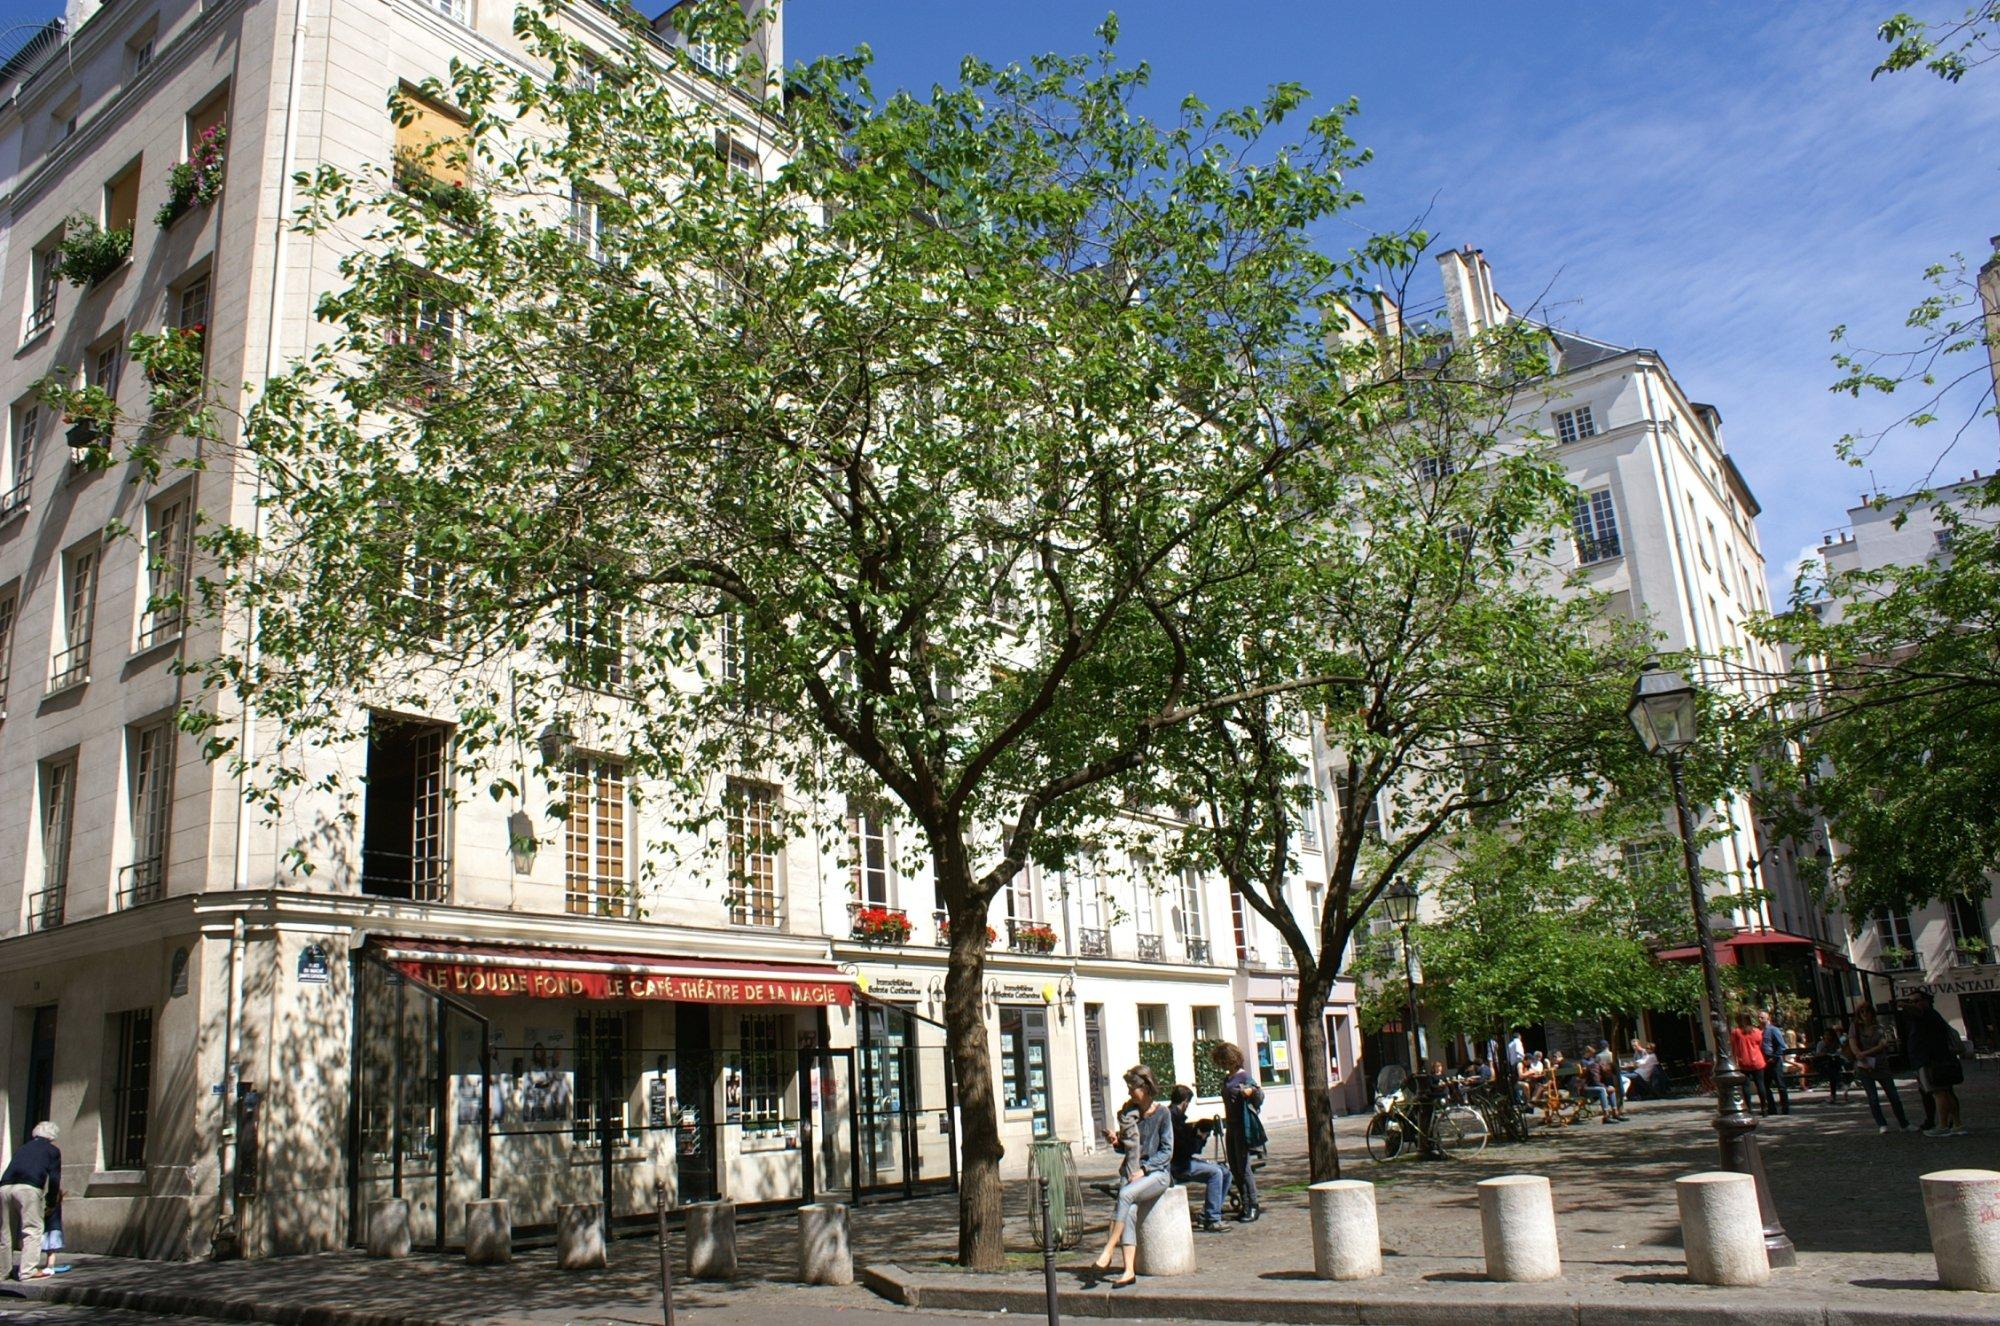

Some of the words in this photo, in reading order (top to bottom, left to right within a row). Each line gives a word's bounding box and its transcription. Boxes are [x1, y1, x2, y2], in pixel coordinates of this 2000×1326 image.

[427, 970, 447, 989] LE
[455, 971, 527, 991] DOUBLE
[535, 975, 583, 994] FOND
[607, 980, 624, 996] LE
[745, 984, 764, 1000] DE
[770, 984, 786, 1001] LA
[791, 984, 836, 1002] MAGIE
